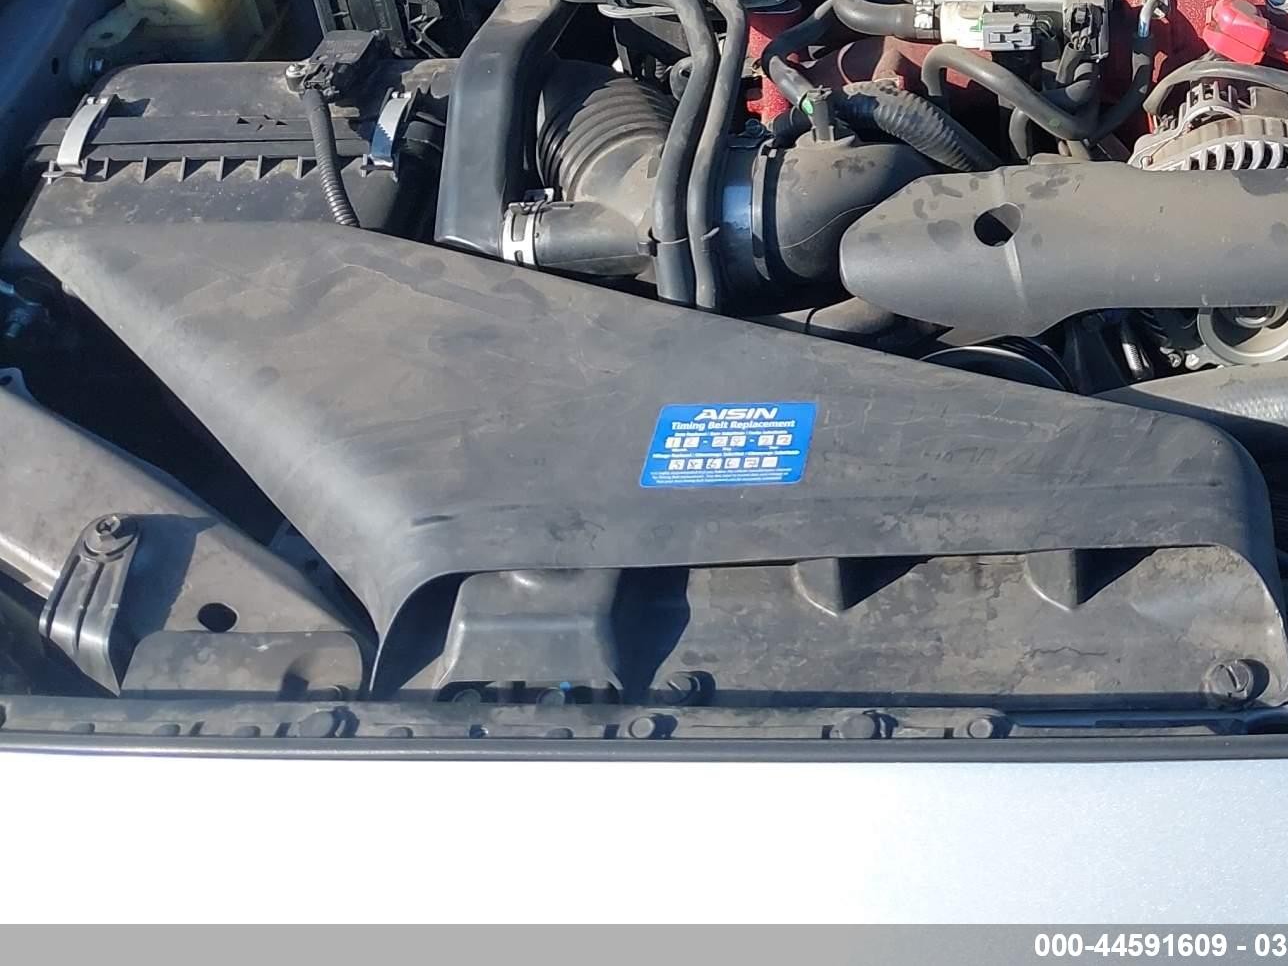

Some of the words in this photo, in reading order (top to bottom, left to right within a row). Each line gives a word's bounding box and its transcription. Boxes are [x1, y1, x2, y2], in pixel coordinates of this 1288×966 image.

[695, 407, 778, 420] AISIN
[672, 422, 706, 431] Timing
[708, 421, 728, 429] Belt
[730, 420, 796, 429] Replacement
